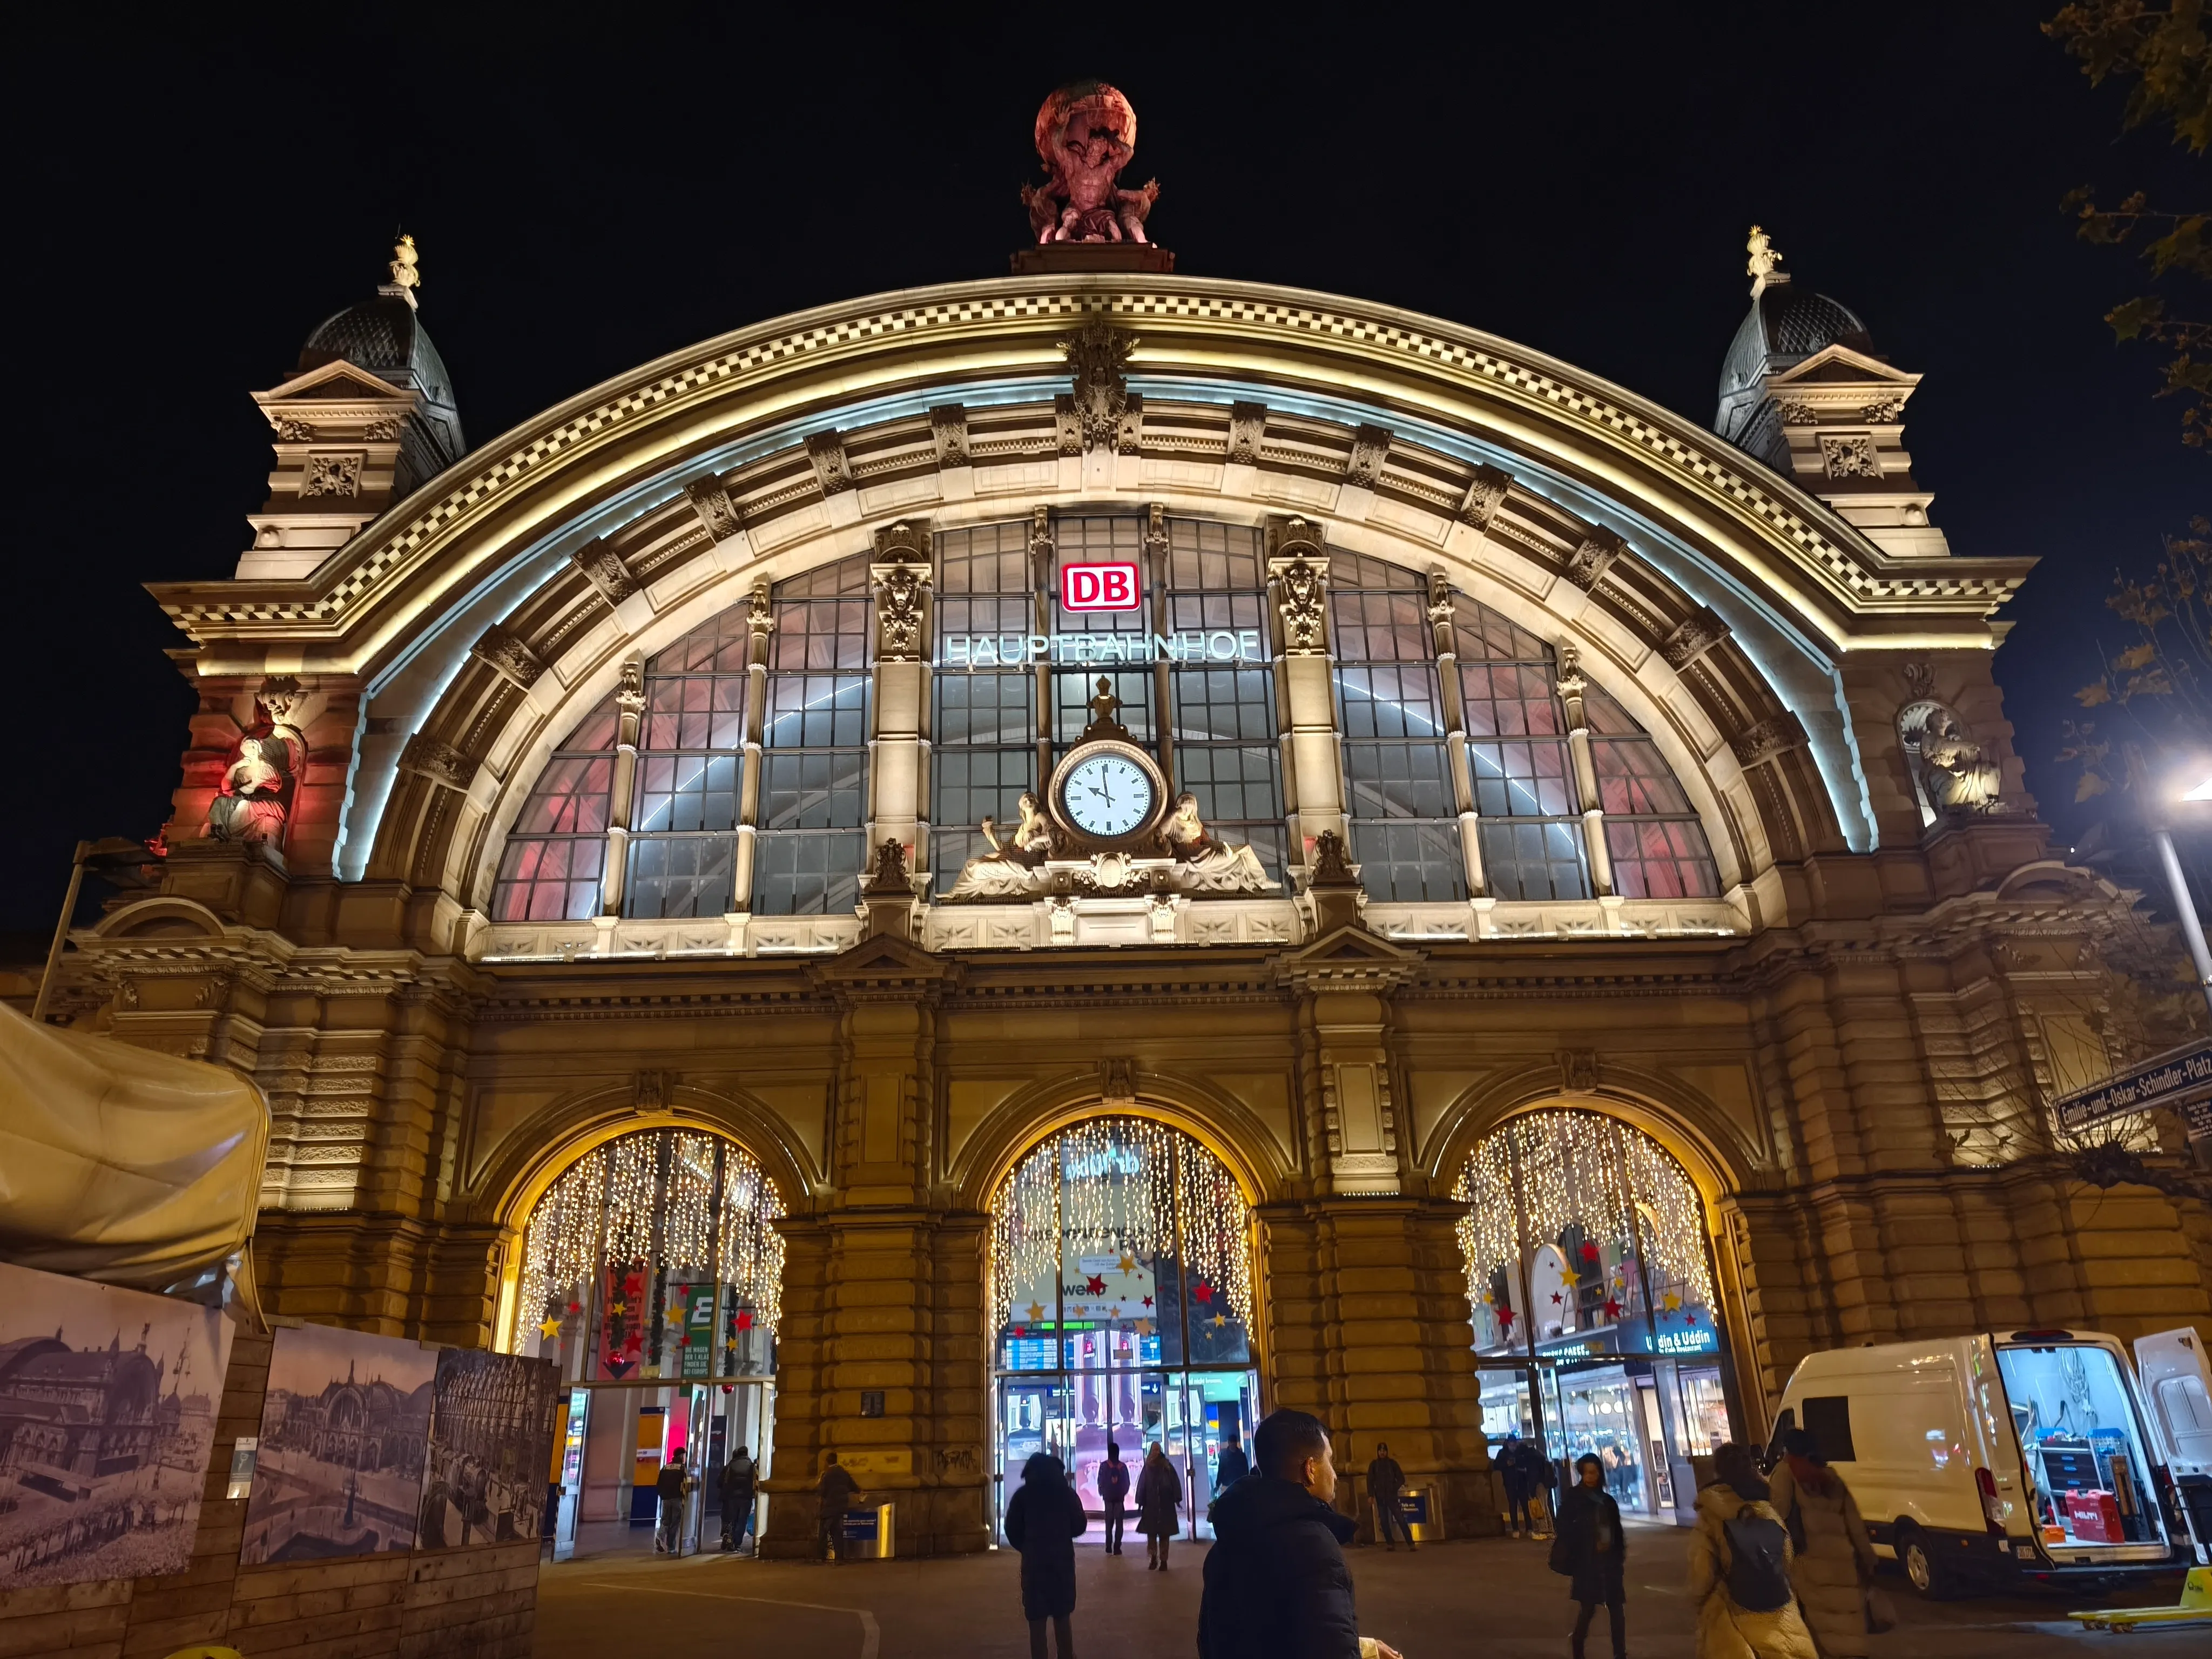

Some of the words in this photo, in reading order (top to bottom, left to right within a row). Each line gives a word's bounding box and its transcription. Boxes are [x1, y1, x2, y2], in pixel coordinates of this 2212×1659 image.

[1073, 571, 1129, 602] DB
[946, 630, 1259, 664] HAUPTBAHNHOF
[2062, 1056, 2212, 1125] Emilie-und-Oskar-Schindler-Platz
[691, 1297, 713, 1323] E
[1645, 1334, 1673, 1351] Udin
[1674, 1333, 1681, 1346] &
[1681, 1329, 1710, 1345] Uddin
[2074, 1510, 2098, 1521] HILTI
